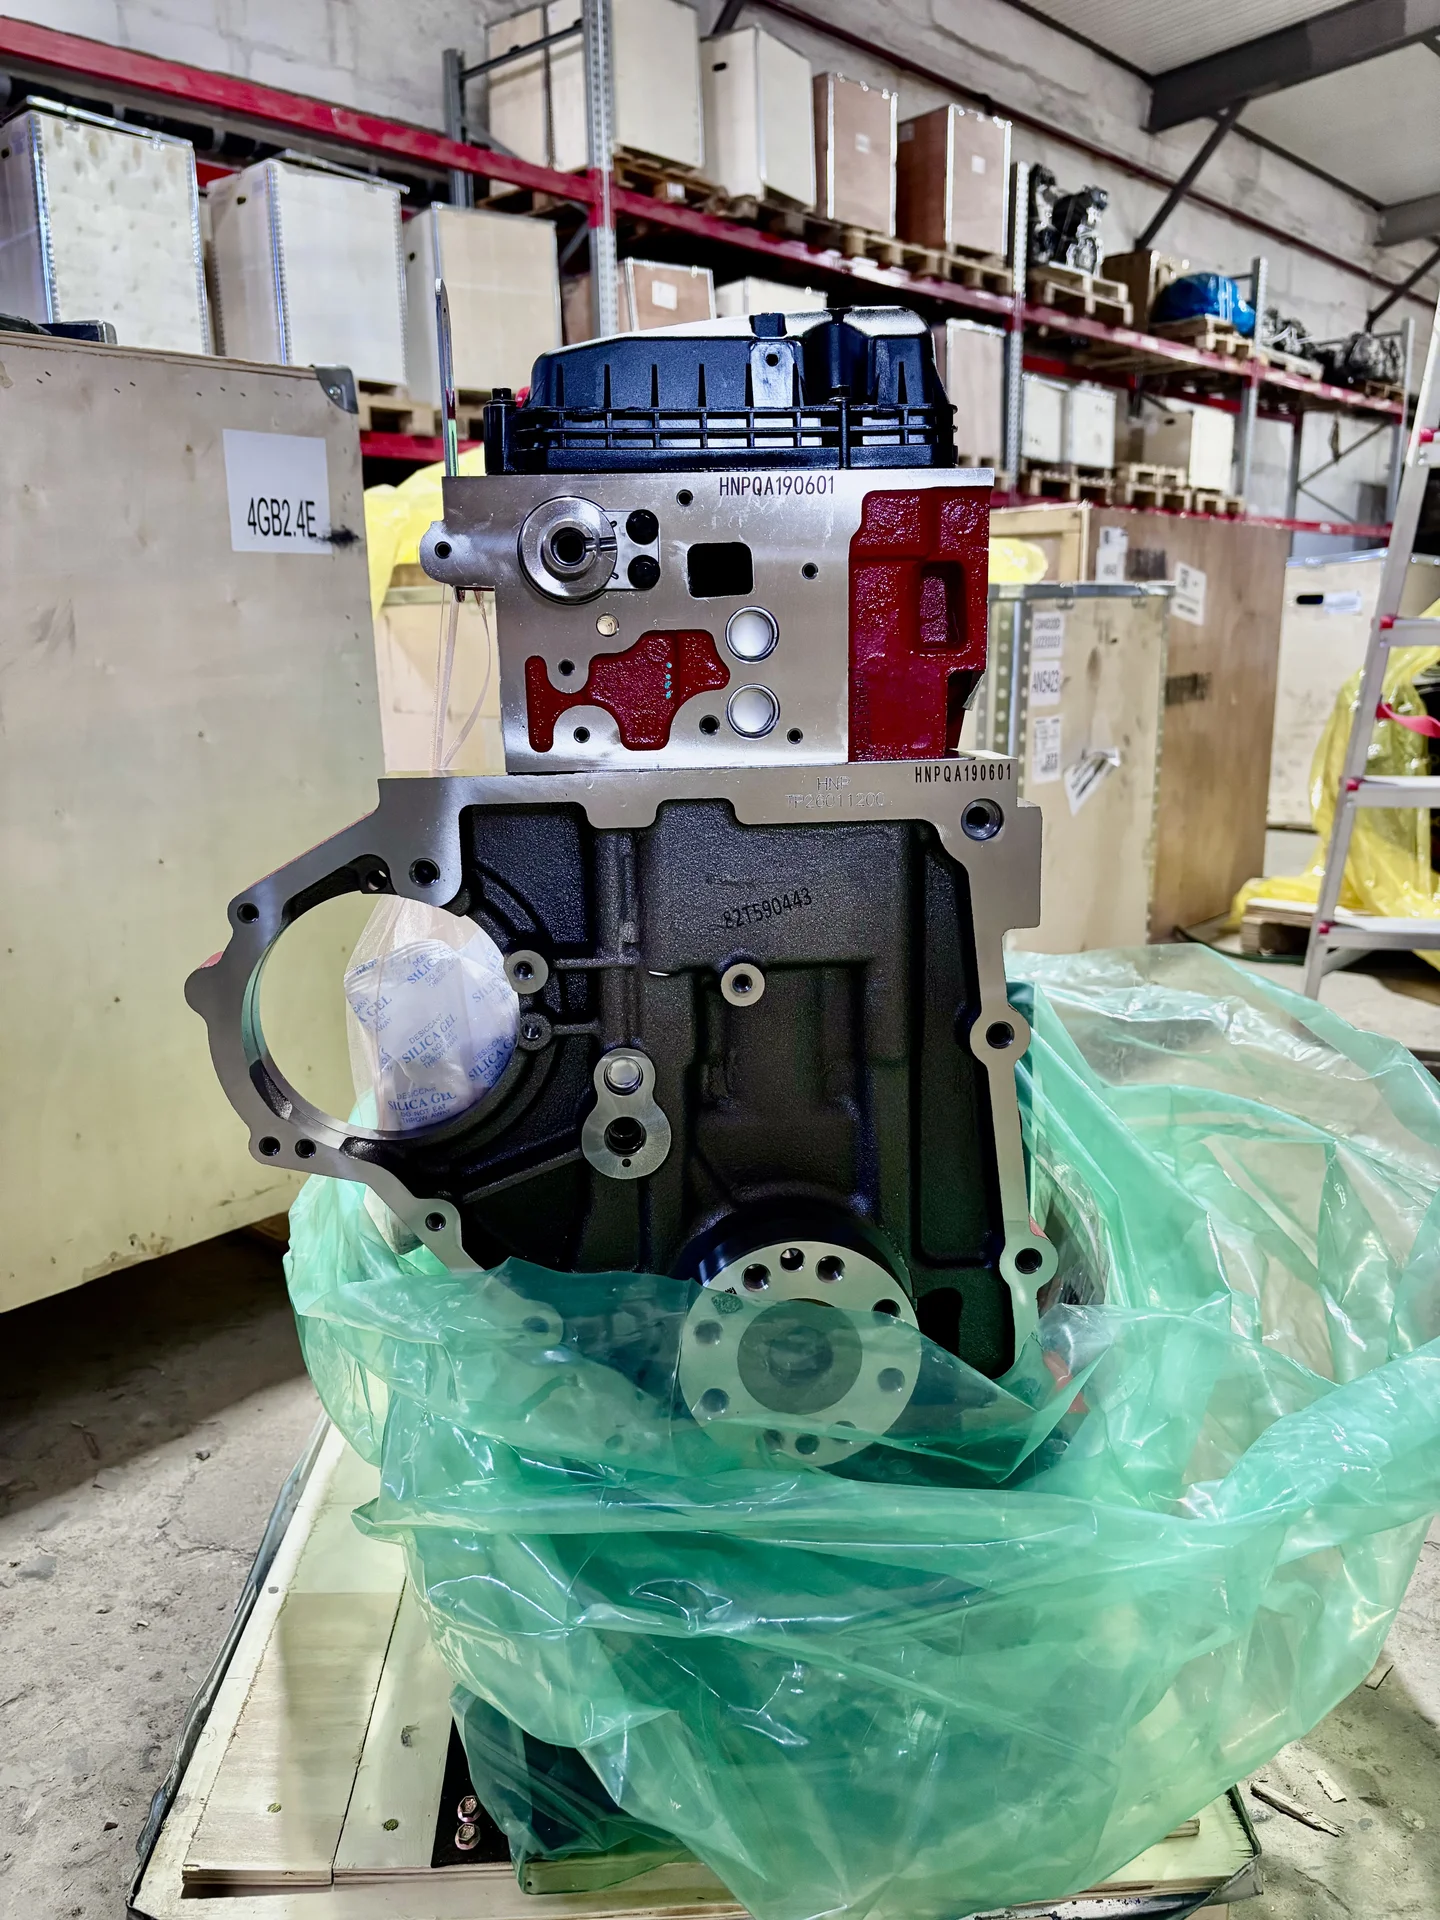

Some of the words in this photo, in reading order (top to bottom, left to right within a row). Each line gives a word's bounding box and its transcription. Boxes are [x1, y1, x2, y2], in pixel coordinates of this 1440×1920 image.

[719, 475, 835, 496] HNPQA190601
[247, 497, 317, 537] 4GB2.4E
[816, 775, 852, 791] HNP
[915, 763, 1011, 783] HNPQA190601
[401, 1031, 441, 1064] SILICA
[440, 1013, 458, 1033] GEL
[408, 1013, 442, 1044] DESICCANT
[468, 1049, 504, 1081] SILICA
[388, 1098, 428, 1112] SILICA
[413, 1108, 429, 1117] NOT
